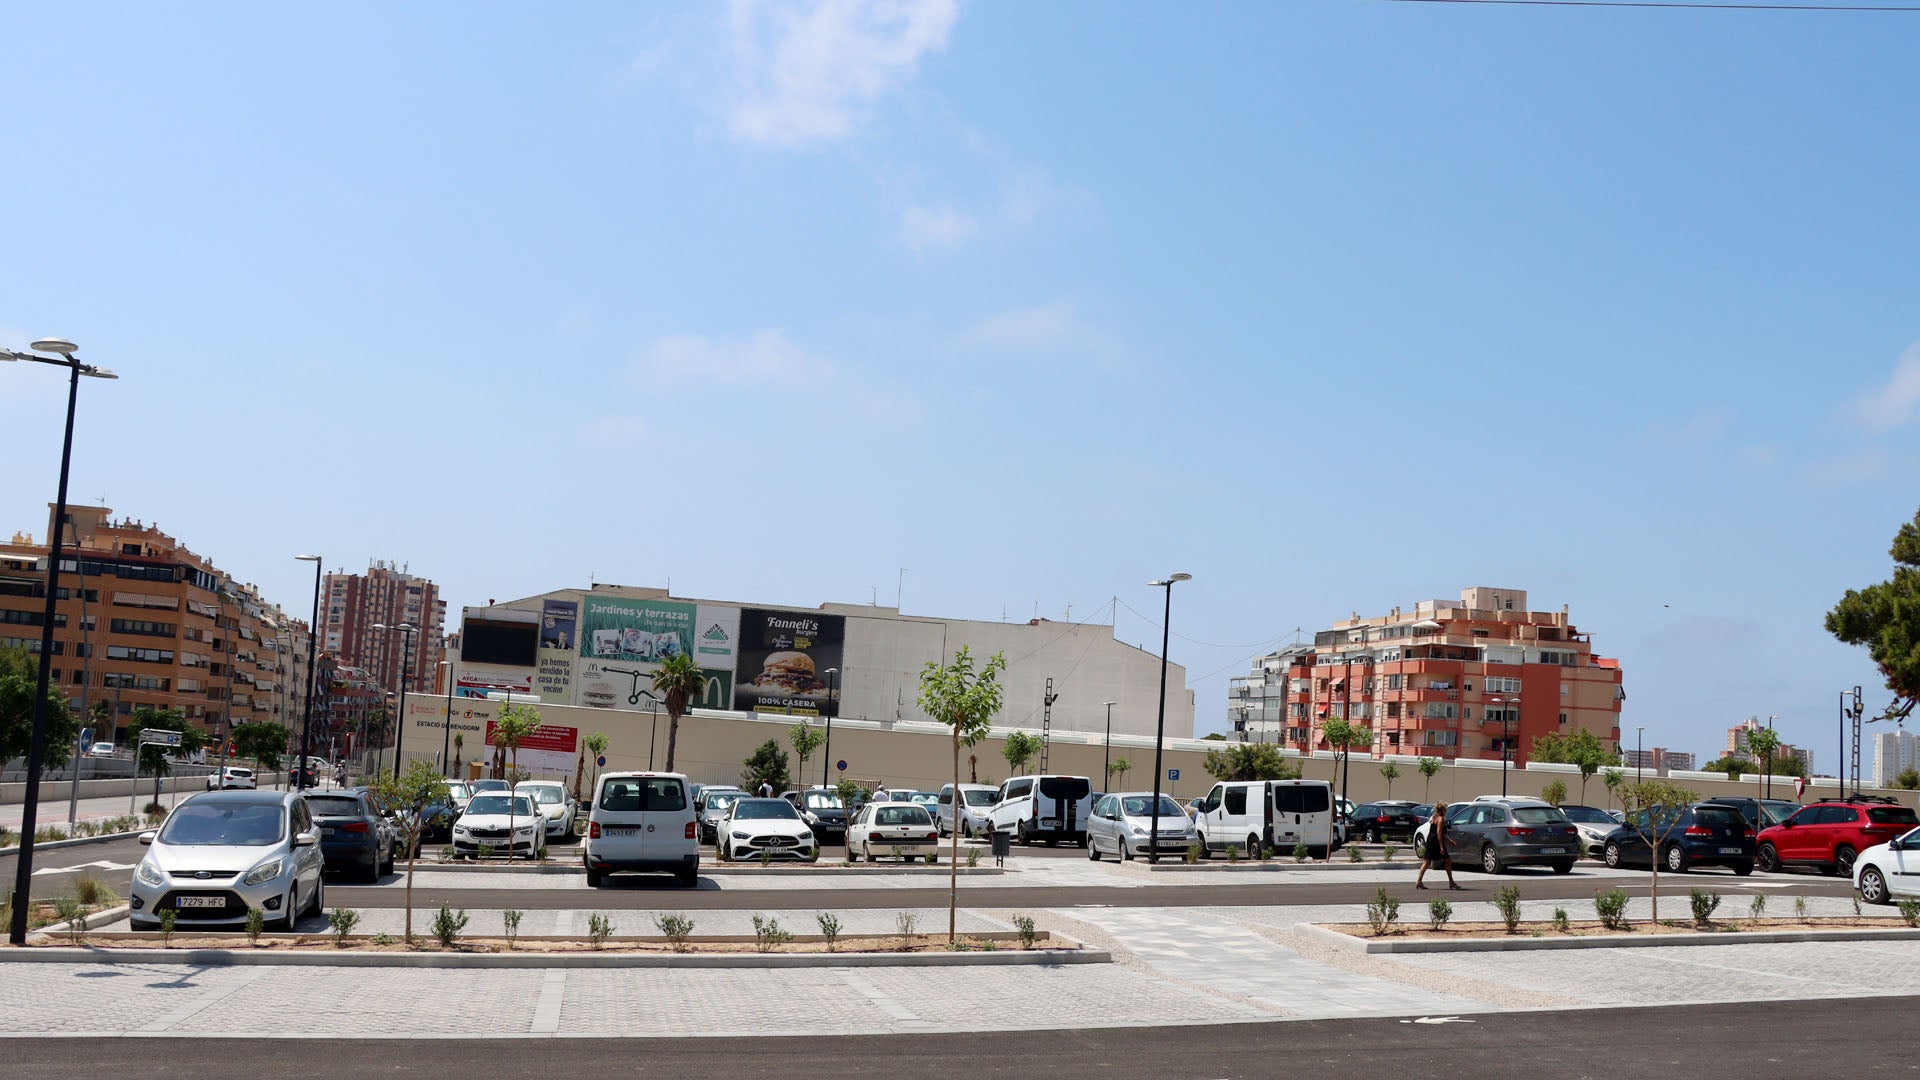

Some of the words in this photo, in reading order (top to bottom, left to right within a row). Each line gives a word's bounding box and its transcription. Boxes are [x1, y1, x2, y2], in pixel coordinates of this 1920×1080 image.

[590, 604, 635, 616] Jardines
[636, 609, 643, 618] y
[645, 608, 689, 620] terrazas
[768, 617, 818, 630] Fanneli's
[703, 625, 716, 639] LEROY
[715, 623, 729, 640] MERLIN
[541, 658, 548, 666] ya
[550, 657, 570, 667] hemos
[540, 666, 563, 676] vendido
[564, 668, 570, 676] la
[554, 676, 561, 684] de
[563, 677, 569, 685] tu
[543, 685, 563, 693] vecino
[758, 697, 780, 705] 100%
[782, 699, 816, 708] CASERA
[183, 898, 203, 906] 7279
[208, 898, 224, 906] HFC
